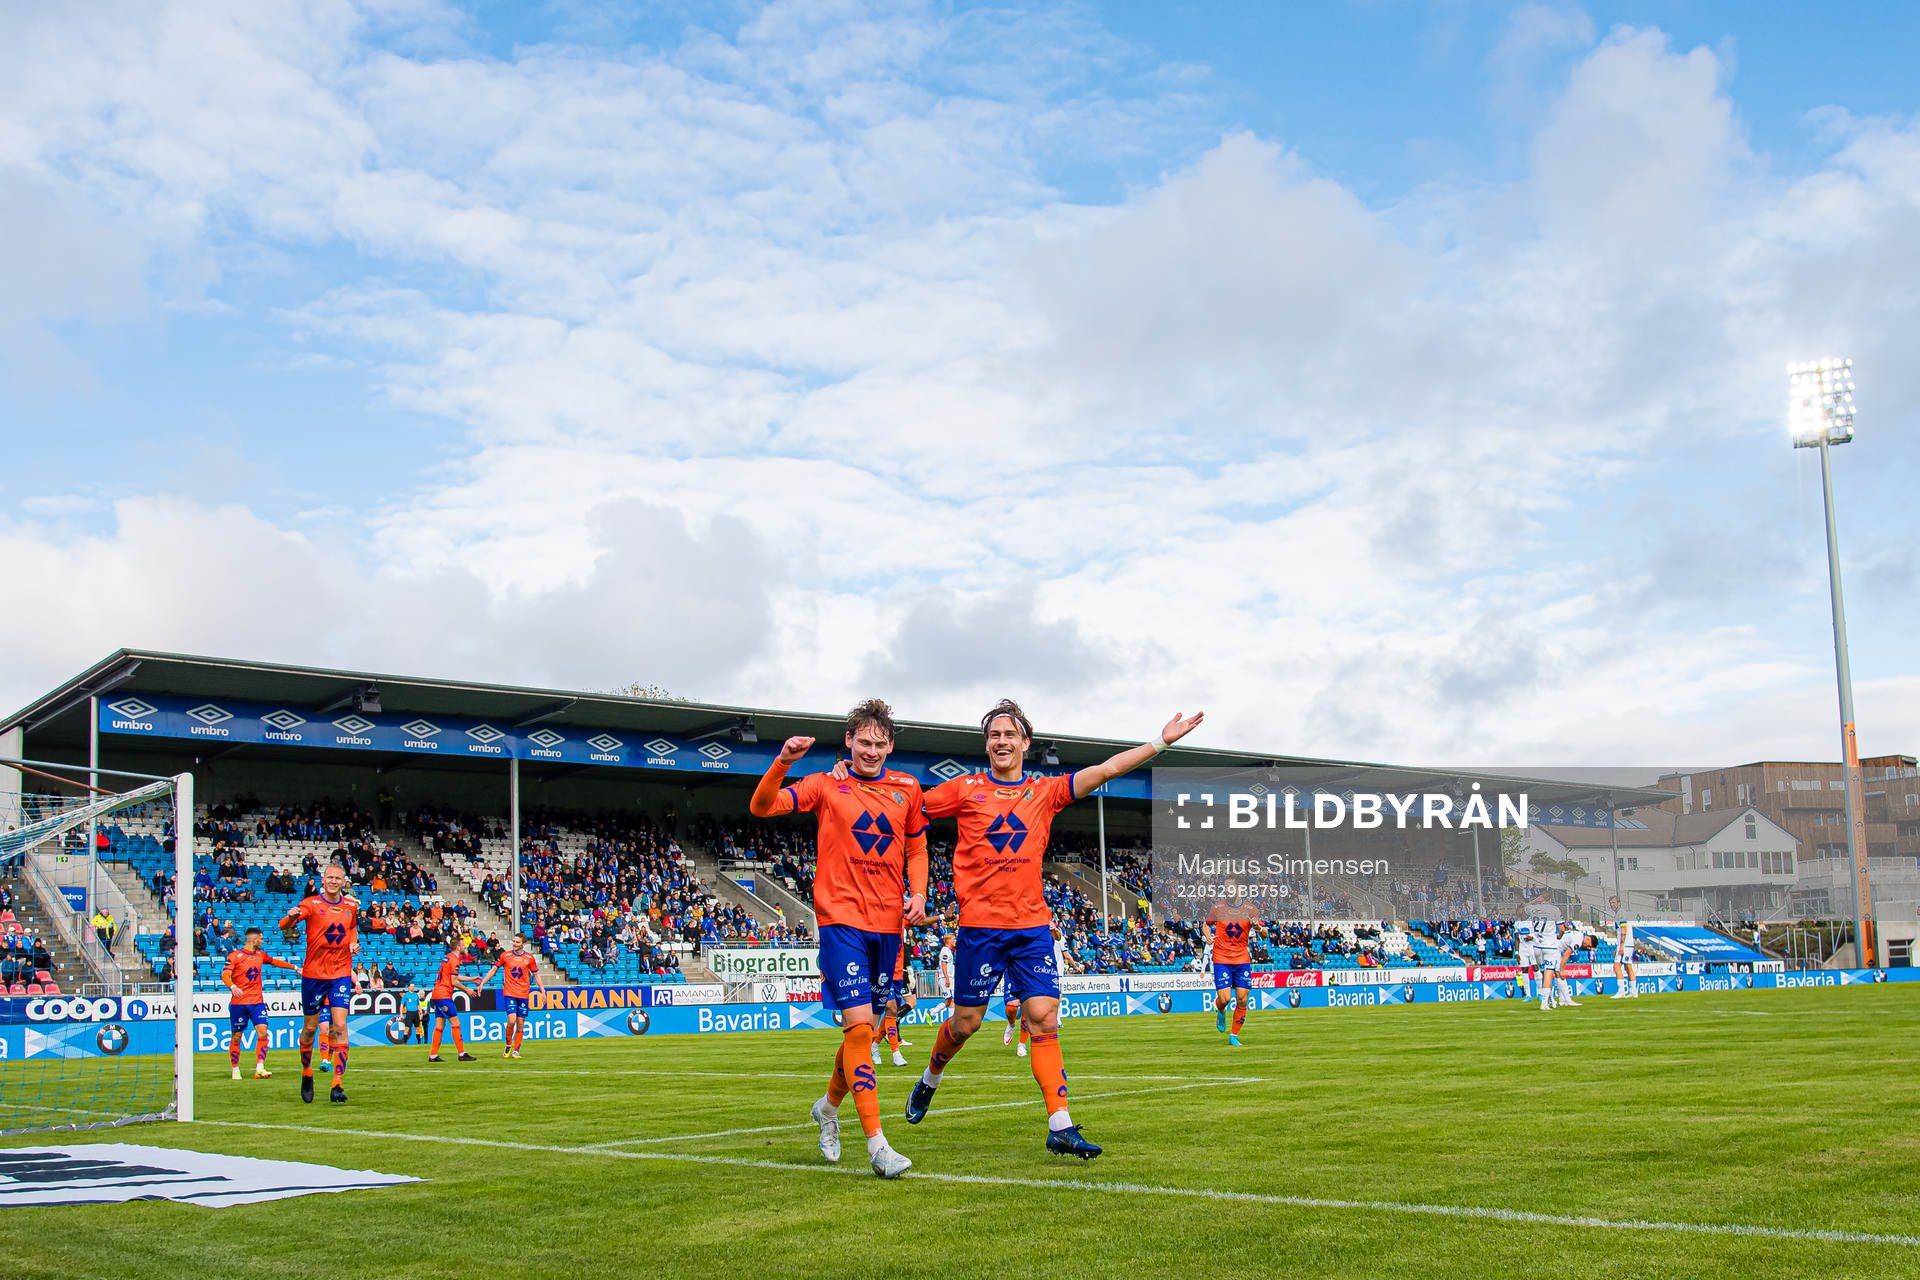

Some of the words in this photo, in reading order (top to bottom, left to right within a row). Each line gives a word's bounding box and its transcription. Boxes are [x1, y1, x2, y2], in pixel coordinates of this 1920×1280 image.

[112, 719, 153, 731] umbro
[190, 725, 229, 737] umbro
[265, 730, 302, 742] umbro
[335, 734, 372, 746] umbro
[403, 739, 438, 750] umbro
[468, 743, 501, 754] umbro
[530, 747, 562, 759] umbro
[589, 751, 620, 762] umbro
[646, 755, 676, 766] umbro
[701, 759, 730, 769] umbro
[713, 952, 809, 977] Biografen
[1133, 979, 1174, 991] Haugesund
[1699, 974, 1729, 992] Bavaria
[1776, 971, 1835, 988] Bavaria
[1088, 982, 1111, 991] Arena
[674, 989, 722, 998] AMANDA
[1327, 987, 1375, 1007] Bavaria
[1437, 983, 1480, 1003] Bavaria
[528, 989, 643, 1011] ORMANN
[1060, 995, 1121, 1017] Bavaria
[25, 997, 118, 1022] coop
[152, 1003, 222, 1014] HAAND
[698, 1006, 781, 1032] Bavaria
